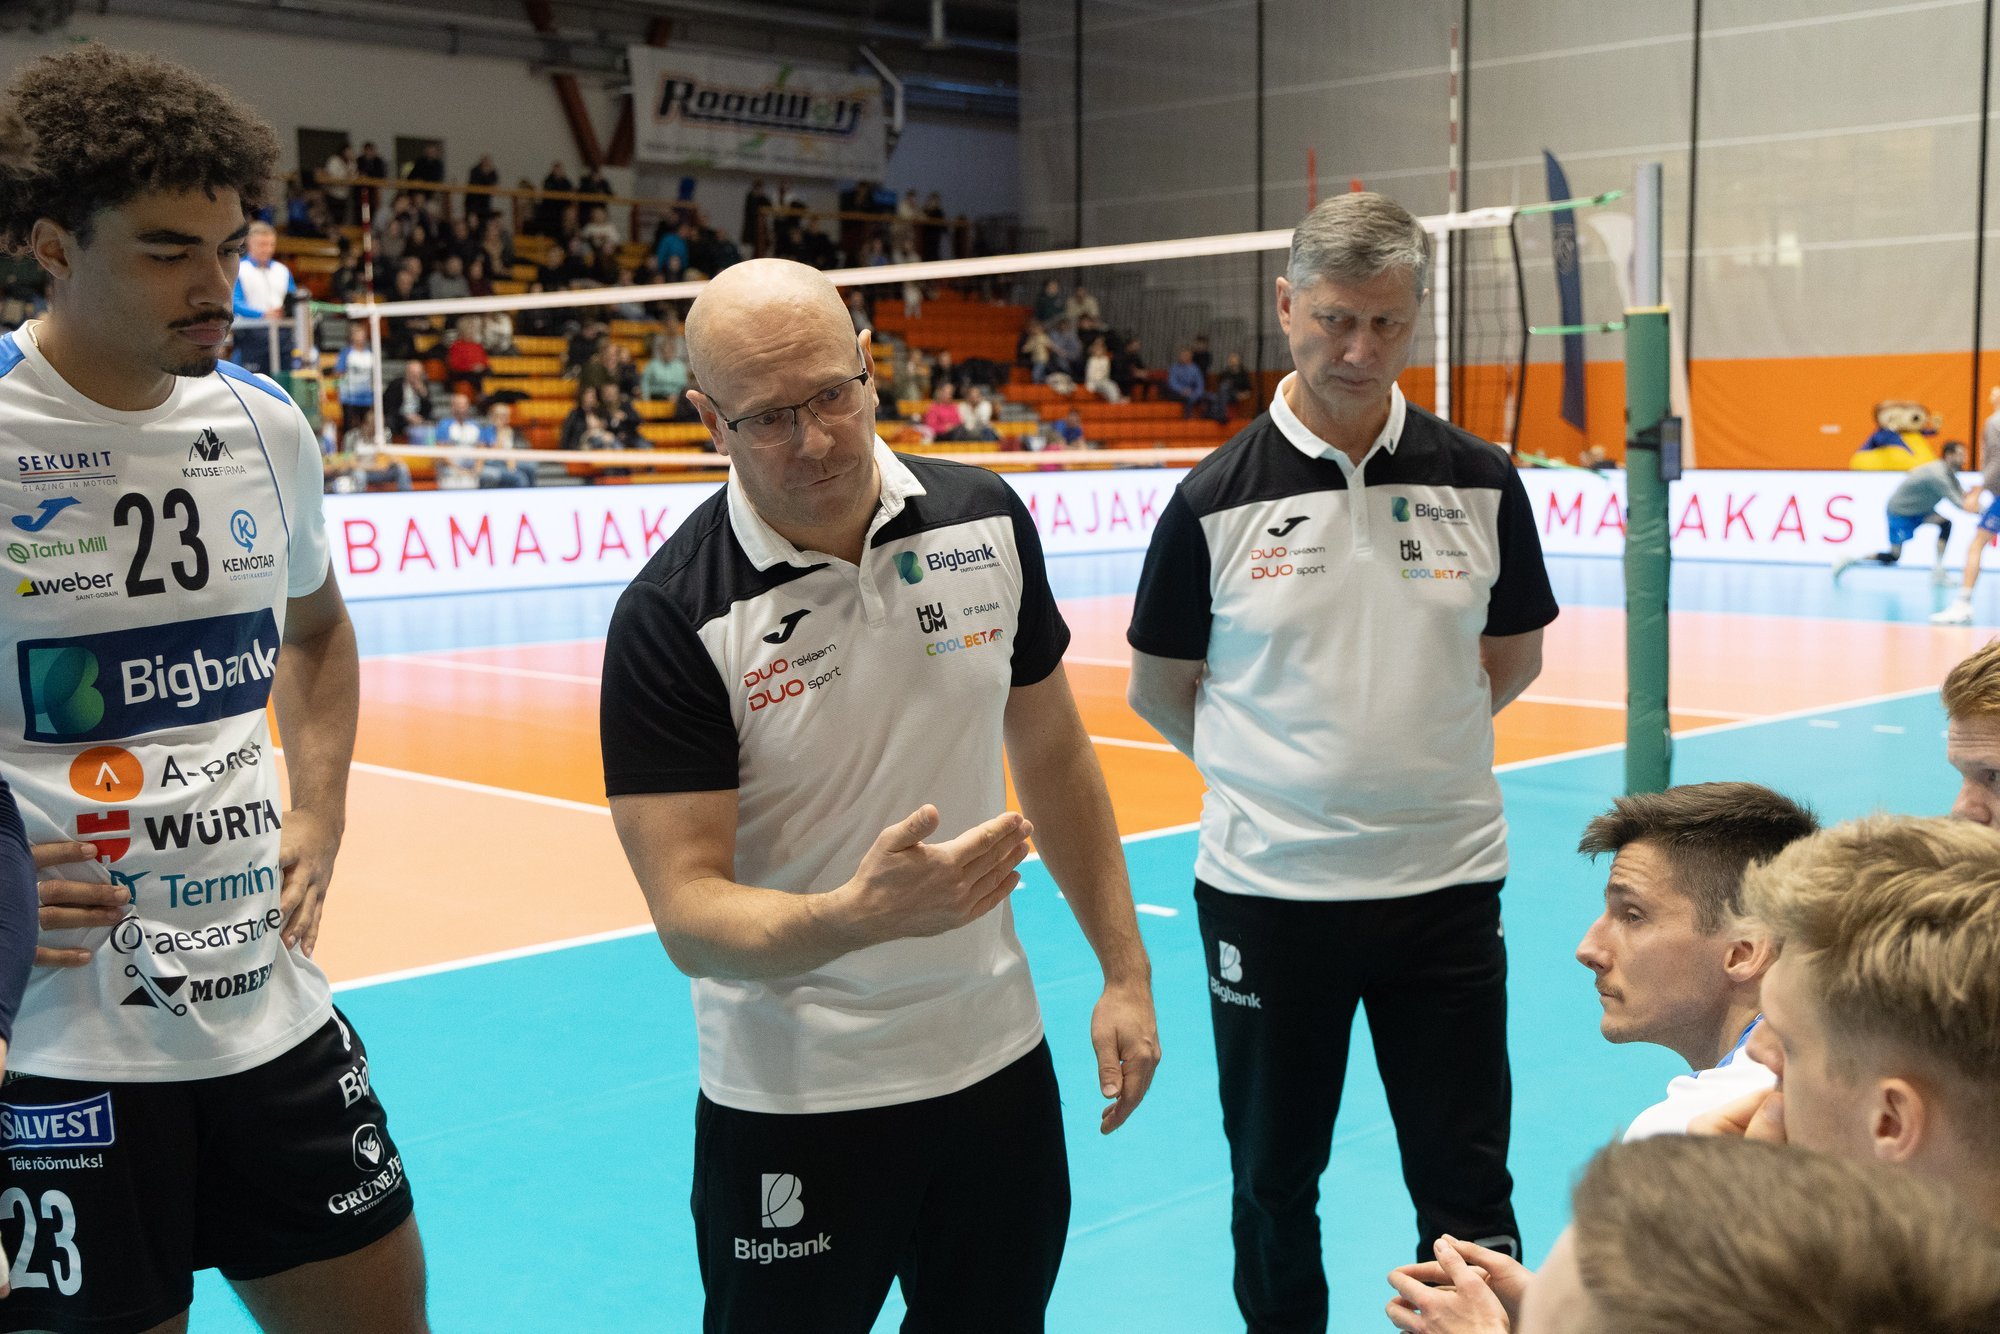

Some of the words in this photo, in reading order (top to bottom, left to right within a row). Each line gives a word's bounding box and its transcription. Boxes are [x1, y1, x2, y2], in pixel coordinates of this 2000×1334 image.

[18, 451, 111, 471] SEKURIT
[182, 465, 247, 478] KATUSEFIRMA
[22, 483, 65, 492] GLAZING
[83, 478, 118, 487] MOTION
[1545, 491, 1856, 544] MAAKAS
[30, 541, 75, 558] Tartu
[78, 536, 108, 554] Mill
[113, 487, 210, 598] 23
[1250, 546, 1287, 560] DUO
[222, 554, 275, 573] KEMOTAR
[926, 543, 996, 572] Bigbank
[38, 571, 114, 595] weber
[1251, 564, 1293, 579] DUO
[1296, 564, 1326, 576] sport
[1401, 568, 1454, 579] COOLBET
[75, 591, 119, 601] SAINT-GOBAIN
[963, 606, 973, 616] OF
[974, 601, 1000, 614] SAUNA
[926, 631, 987, 657] COOLBET
[120, 638, 277, 709] Bigbank
[743, 658, 788, 687] DUO
[791, 643, 837, 669] reklaam
[748, 679, 805, 712] DUO
[808, 665, 842, 690] sport
[1210, 976, 1262, 1010] Bigbank
[0, 1105, 102, 1140] SALVEST
[8, 1156, 32, 1171] Teie
[33, 1153, 104, 1171] rõõmuks!
[328, 1170, 393, 1215] GRÜNE
[0, 1187, 82, 1296] 23
[734, 1232, 832, 1265] Bigbank
